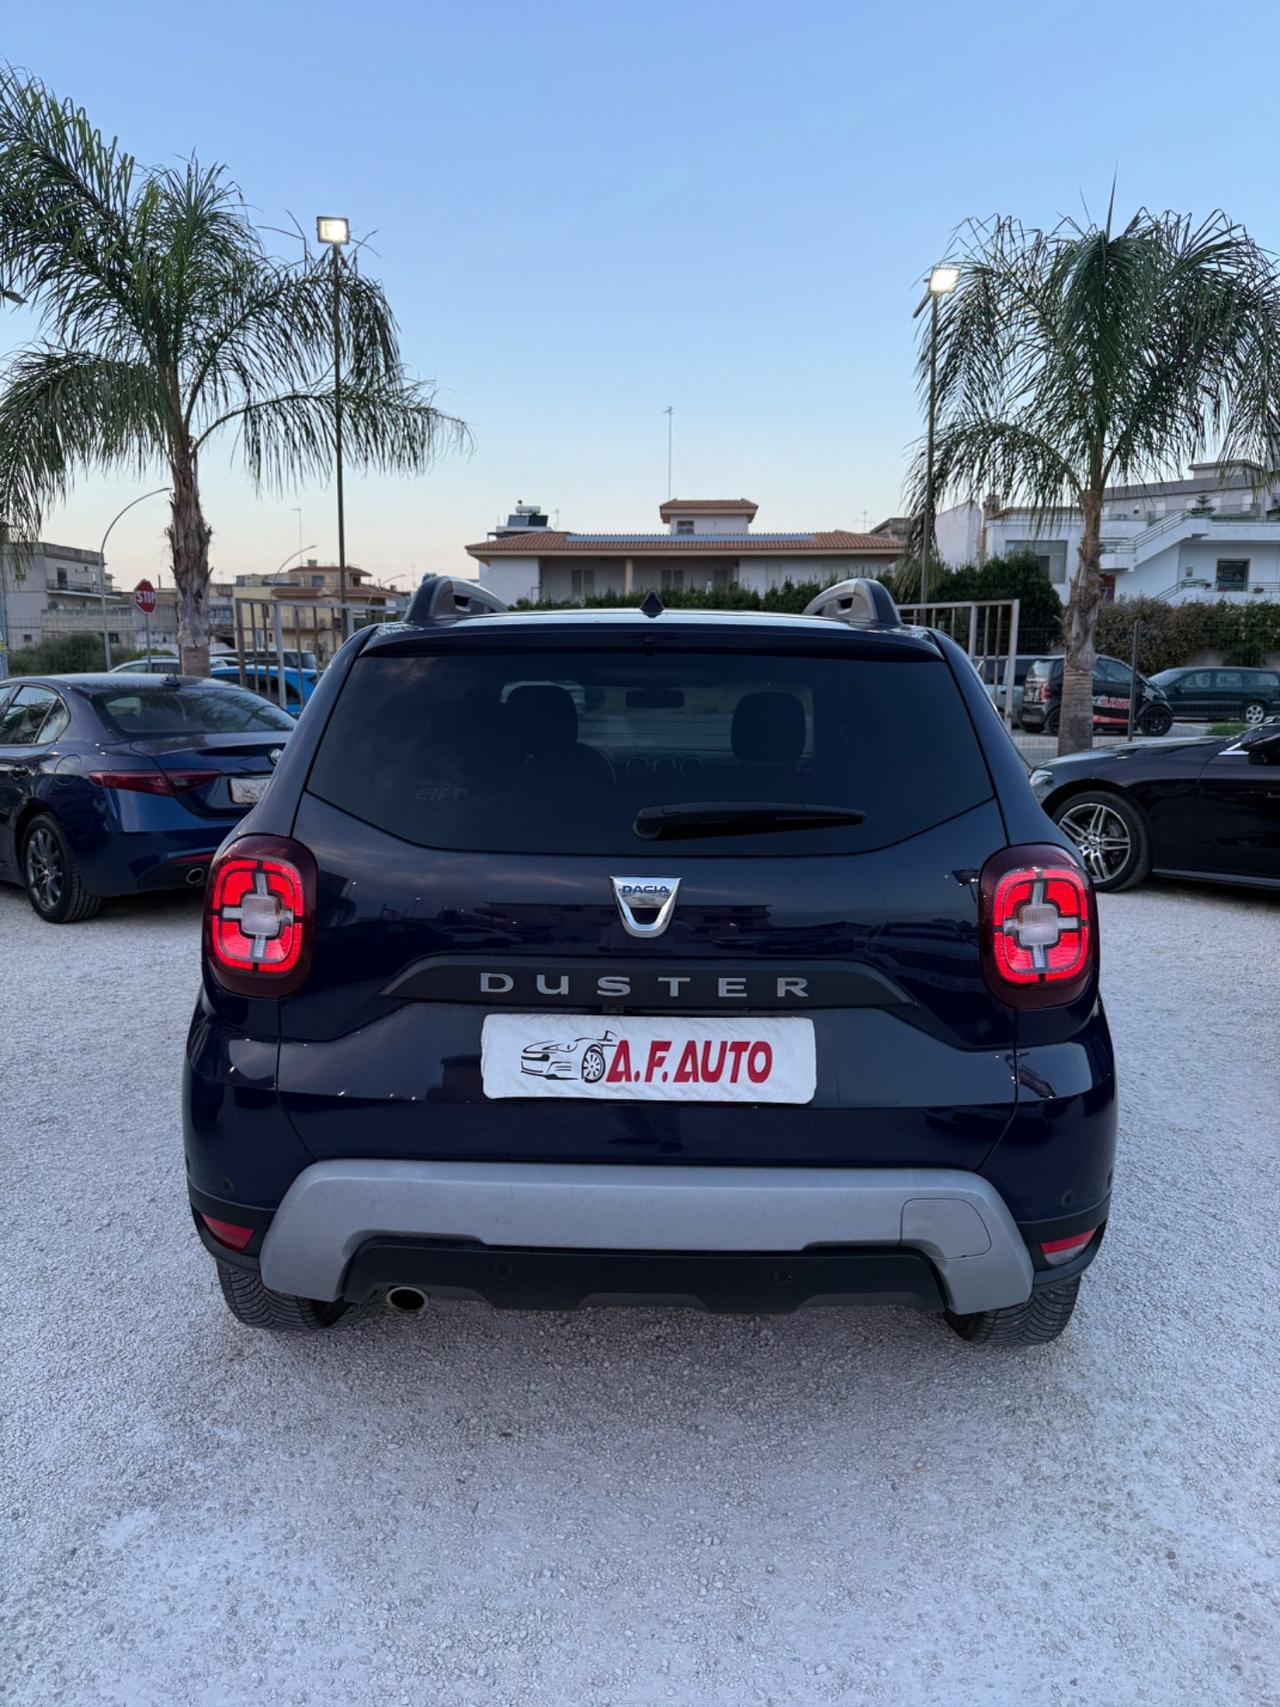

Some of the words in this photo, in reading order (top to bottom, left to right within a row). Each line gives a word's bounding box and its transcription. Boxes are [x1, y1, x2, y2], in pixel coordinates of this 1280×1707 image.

[136, 590, 156, 604] STOP
[622, 885, 669, 894] DACIA
[480, 972, 809, 998] DUSTER
